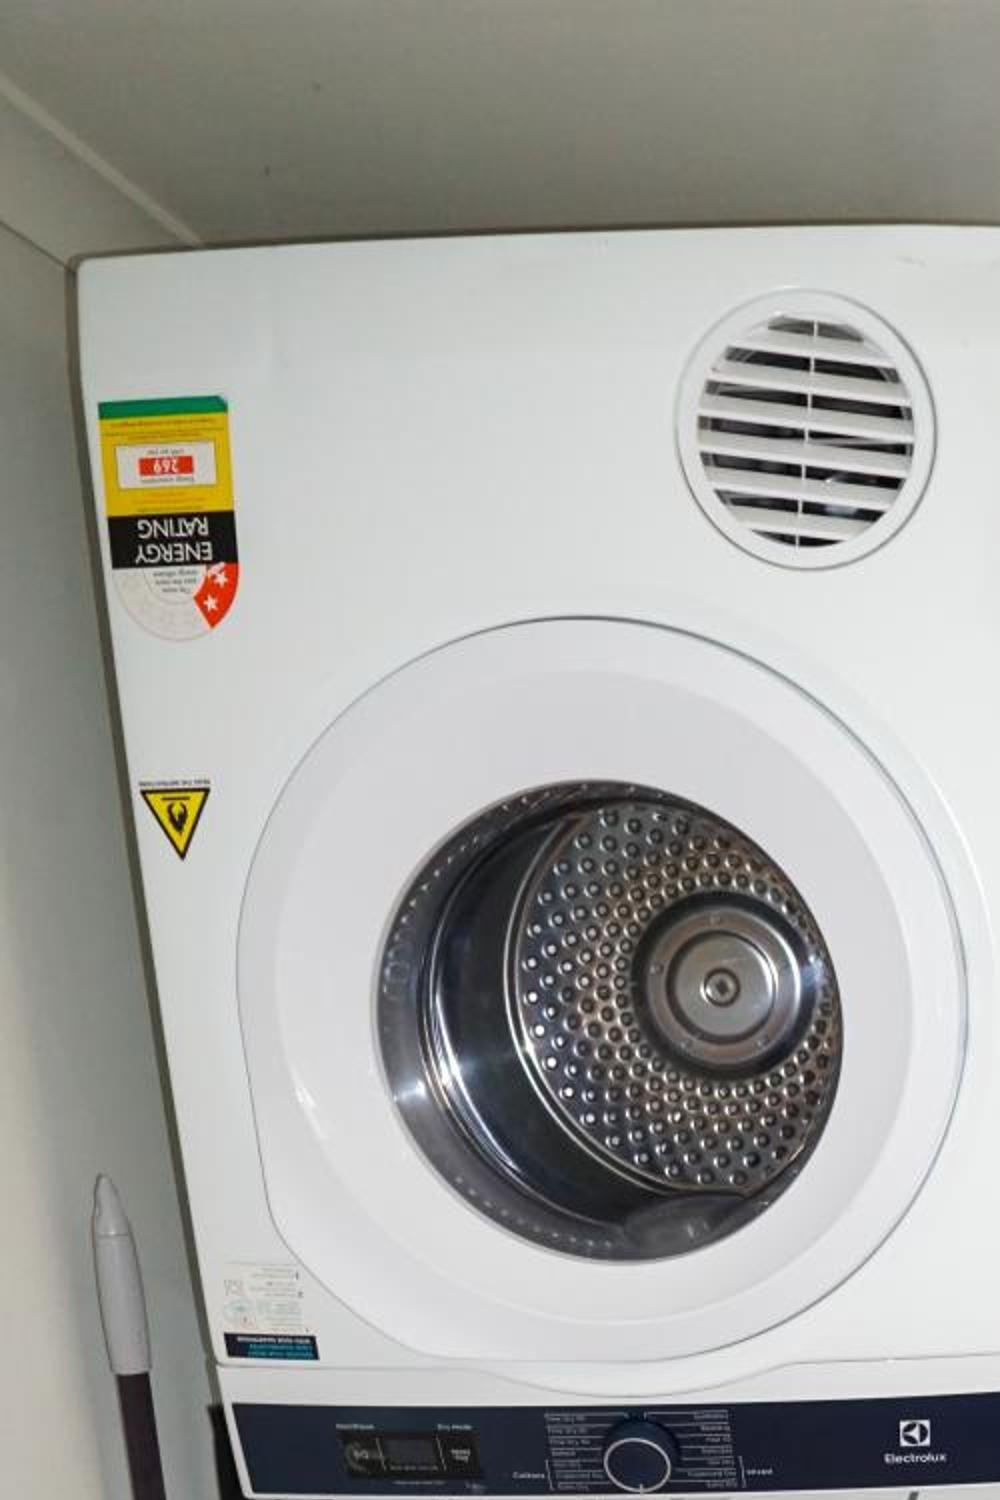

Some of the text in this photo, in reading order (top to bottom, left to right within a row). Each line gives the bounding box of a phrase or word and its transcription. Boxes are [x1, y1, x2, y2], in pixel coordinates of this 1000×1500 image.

[153, 457, 180, 474] 269
[137, 516, 209, 539] RATING
[135, 541, 213, 565] ENERGY
[884, 1453, 947, 1465] Electrolux
